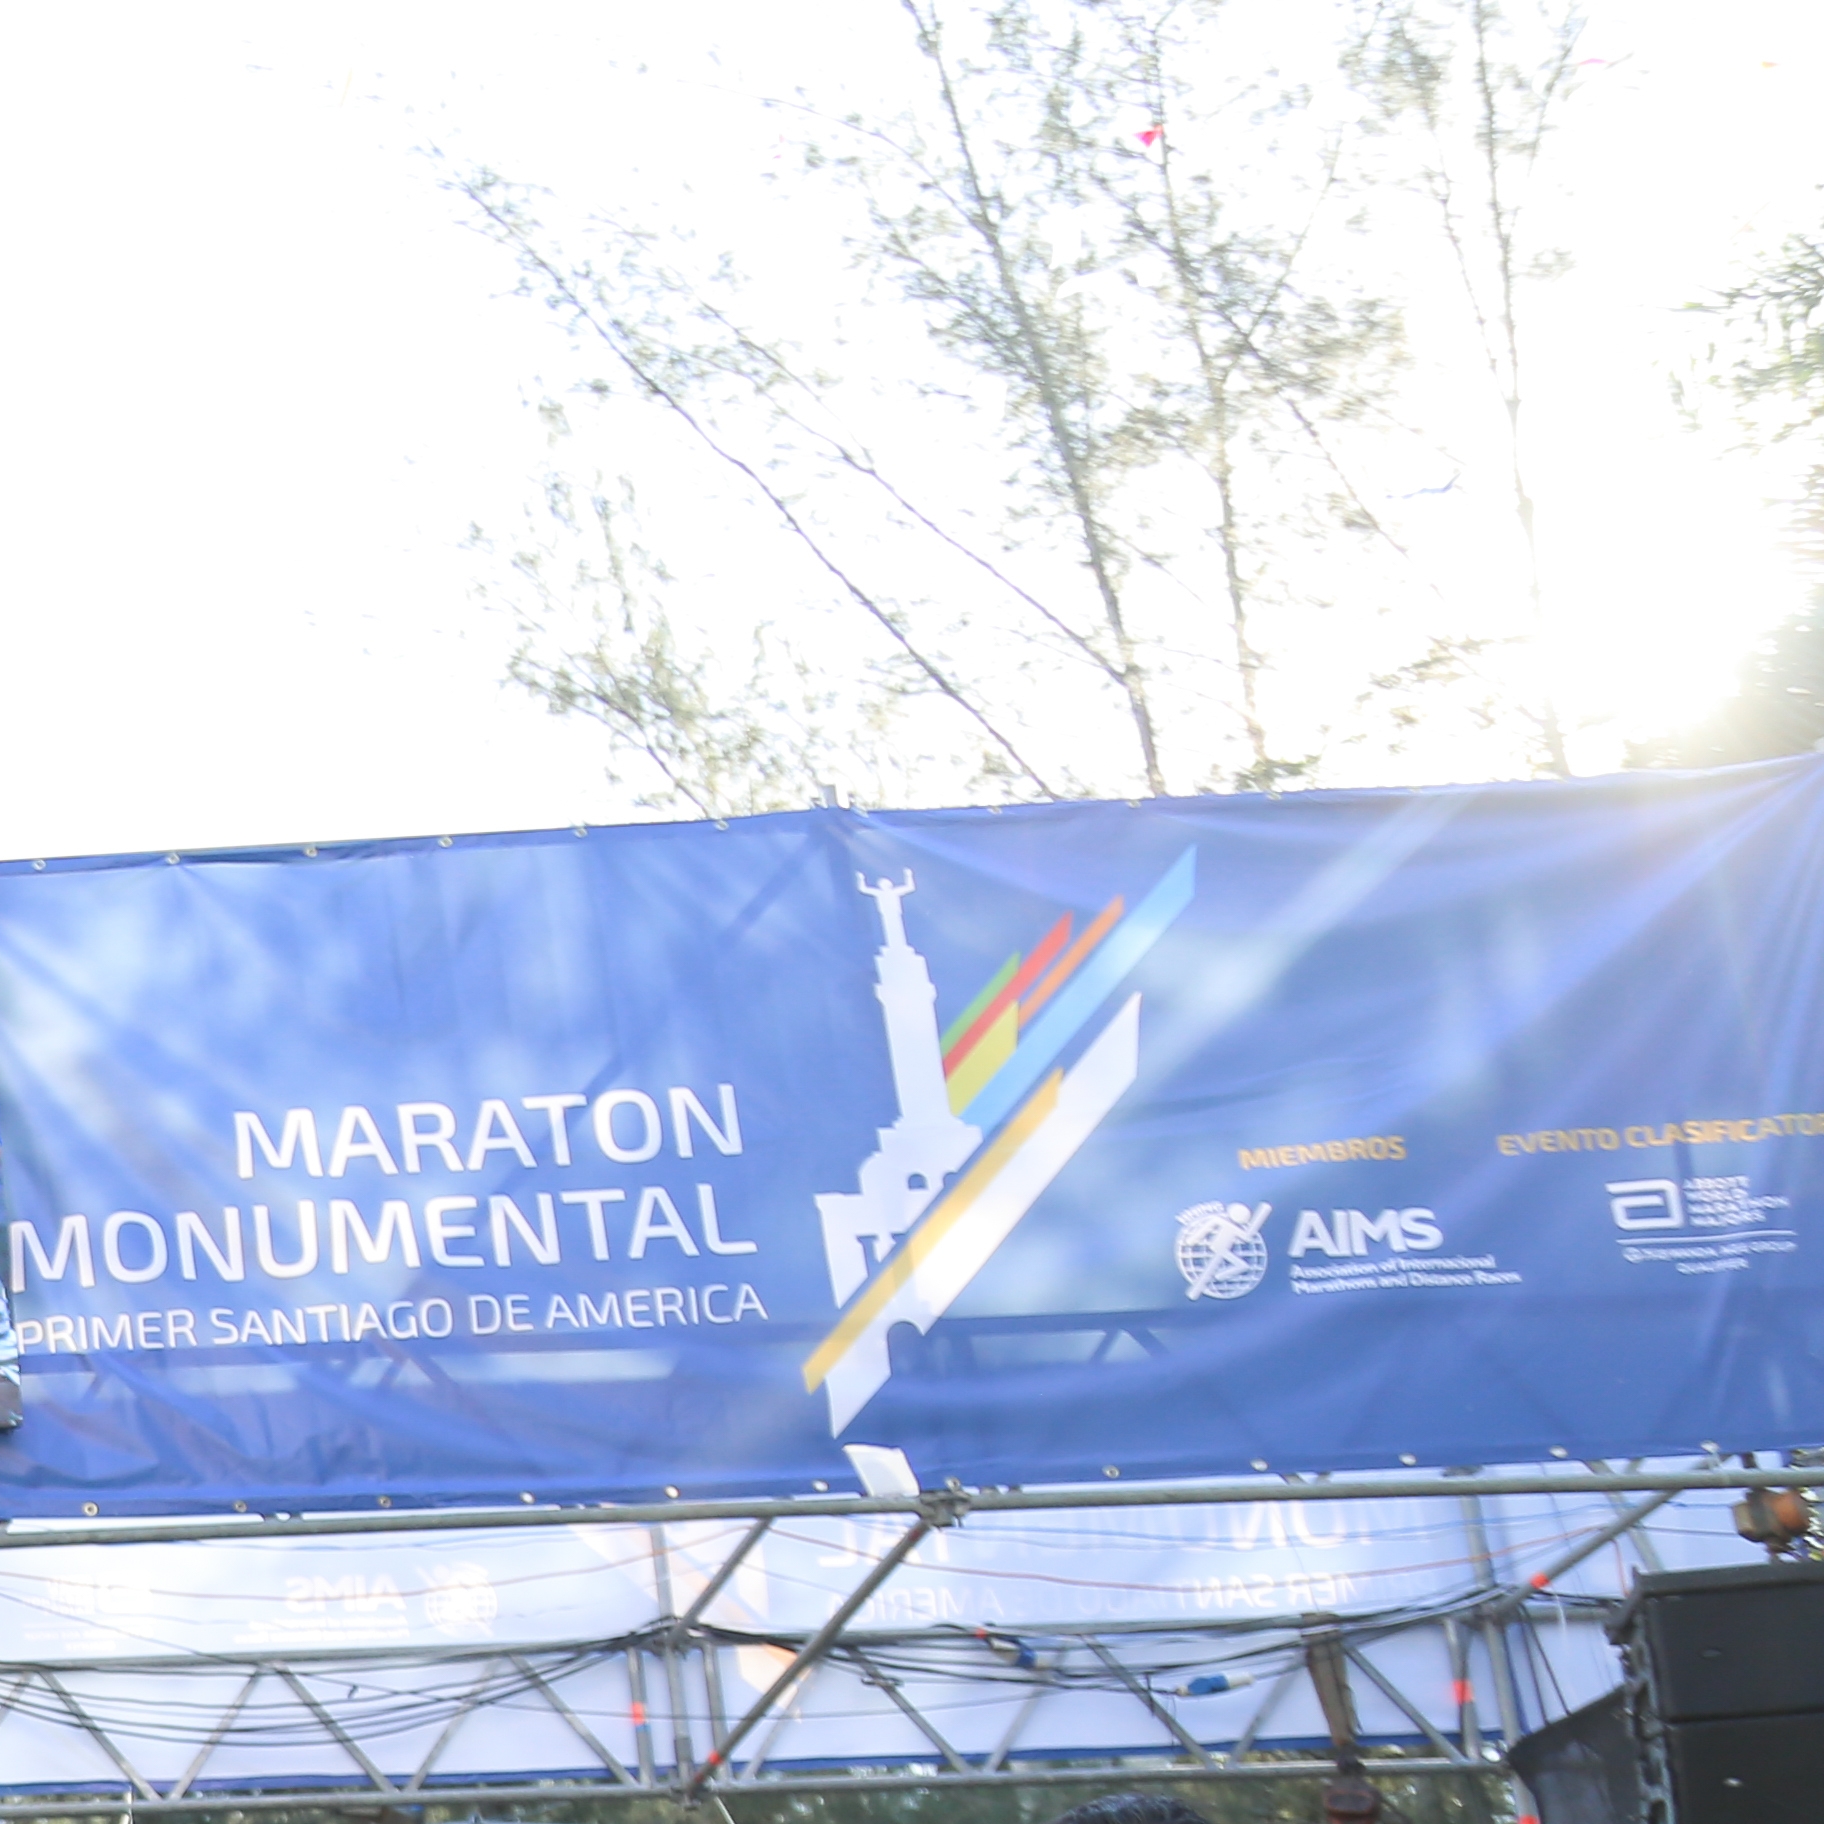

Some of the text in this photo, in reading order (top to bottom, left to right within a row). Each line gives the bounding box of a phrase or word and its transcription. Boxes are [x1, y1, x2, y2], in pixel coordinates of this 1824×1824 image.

[233, 1083, 744, 1180] MARATON
[1239, 1135, 1406, 1170] MIEMBROS
[1497, 1127, 1619, 1155] EVENTO
[10, 1182, 758, 1294] MONUMENTAL
[1288, 1207, 1444, 1257] AIMS
[16, 1283, 768, 1356] PRIMER SANTIAGO DE AMERICA
